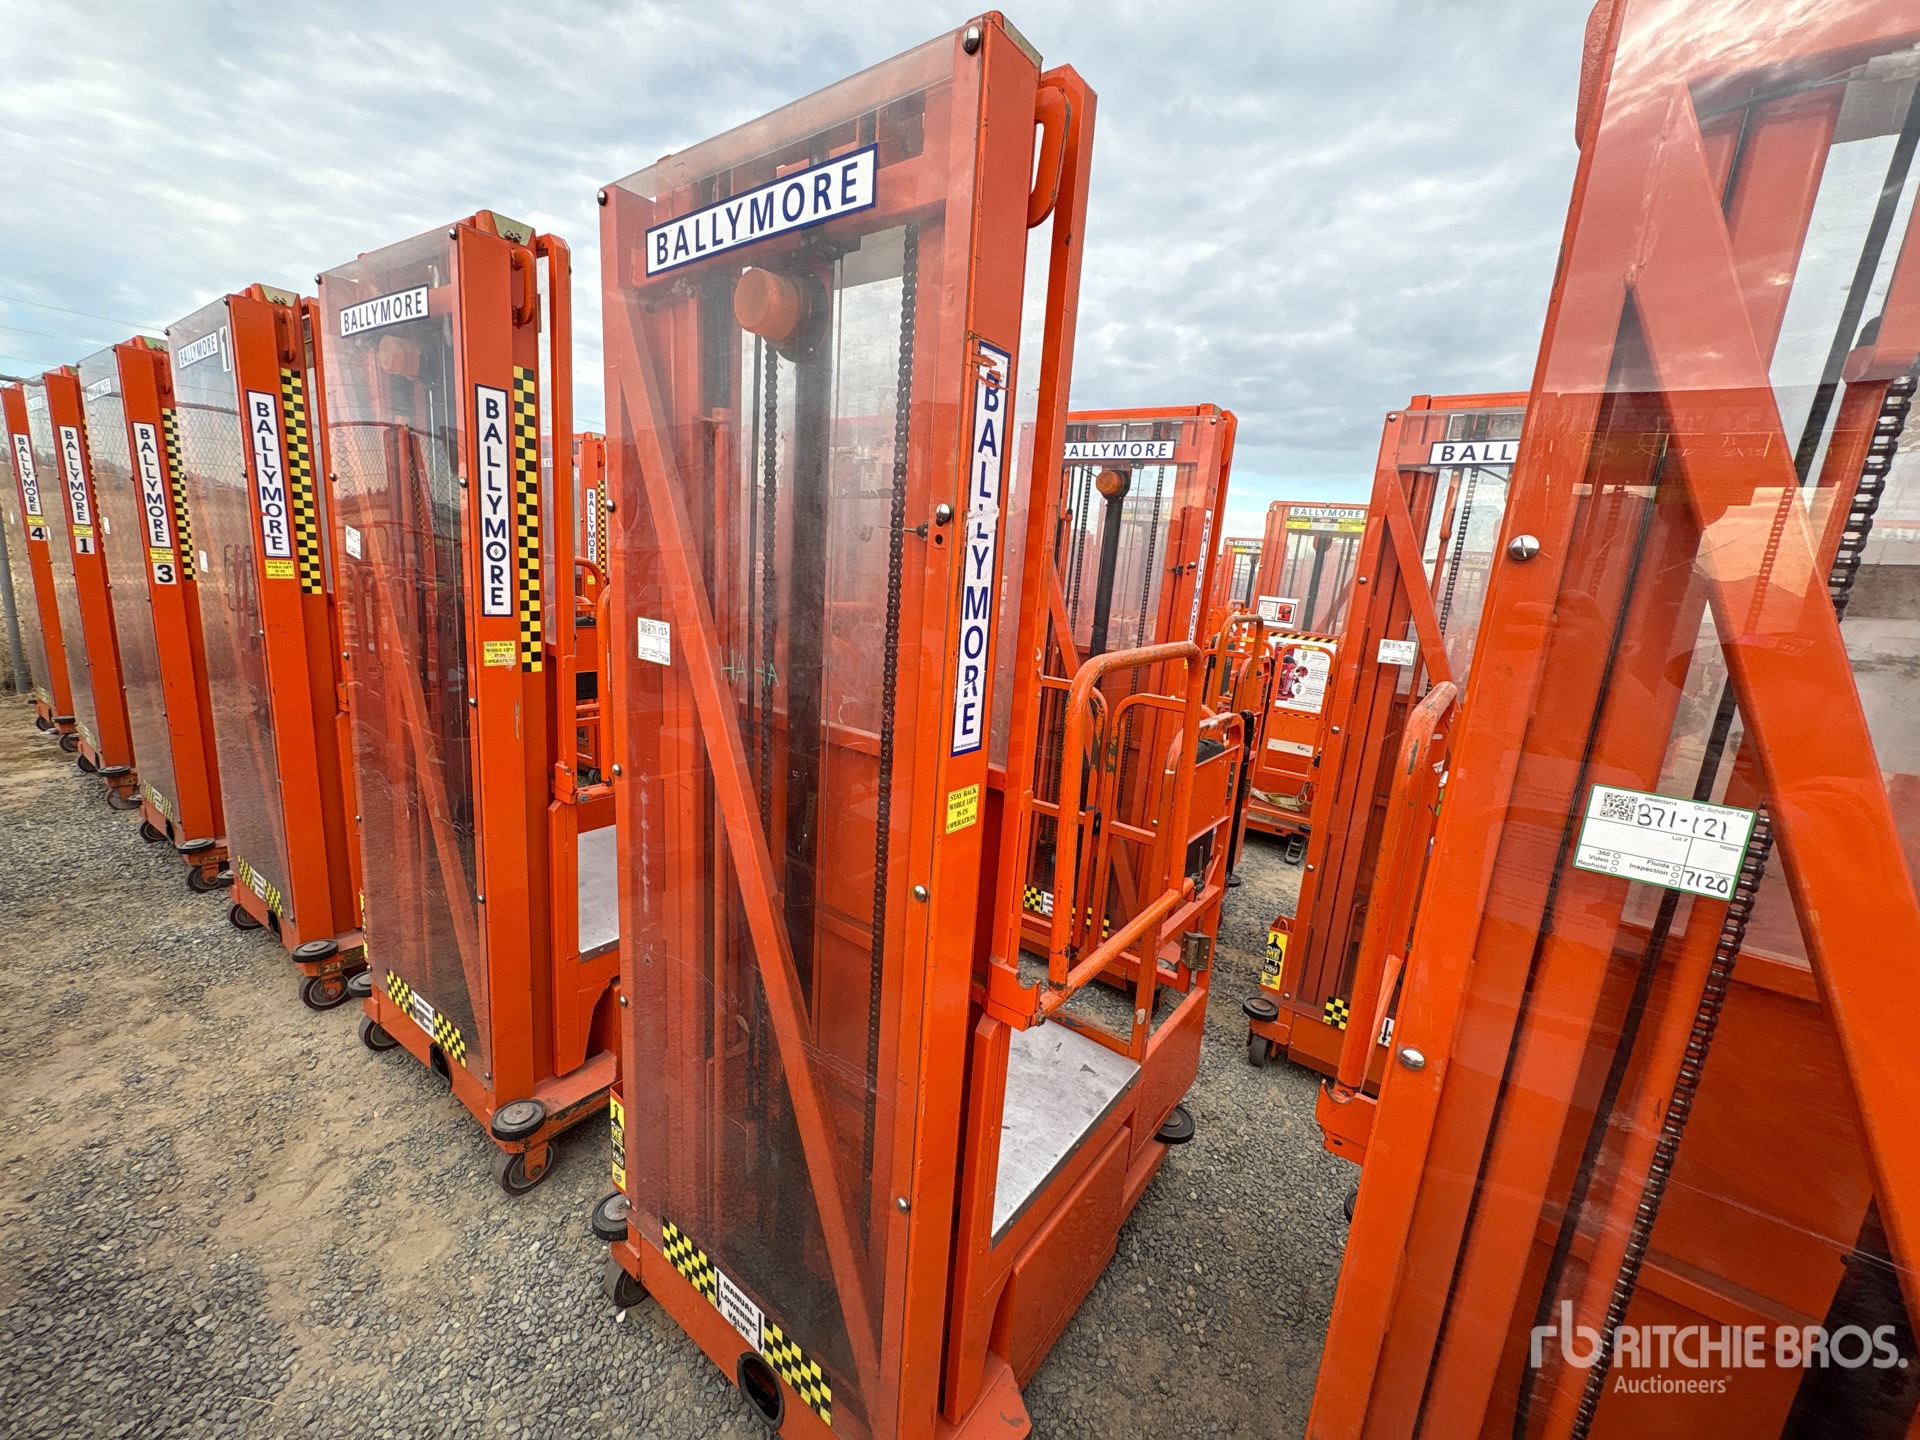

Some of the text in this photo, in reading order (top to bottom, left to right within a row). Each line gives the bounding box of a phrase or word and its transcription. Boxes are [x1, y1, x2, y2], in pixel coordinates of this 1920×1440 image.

[656, 161, 858, 266] BALLYMORE
[343, 288, 423, 333] BALLYMORE
[179, 335, 217, 367] BALLYMORE
[1441, 444, 1519, 462] BALL
[17, 437, 38, 513] BALLYMORE
[64, 430, 87, 521] BALLYMORE
[255, 401, 284, 551] BALLYMORE
[139, 428, 166, 543] BALLYMORE
[483, 397, 507, 607] BALLYMORE
[1293, 507, 1362, 518] BALLYMORE
[32, 527, 44, 540] 4
[79, 538, 90, 553] 1
[960, 373, 1000, 737] BALLYMORE
[157, 564, 173, 583] 3
[719, 645, 780, 688] HA HA
[950, 788, 977, 801] STAY BACK
[949, 796, 977, 810] WHILE LIFT
[956, 807, 969, 818] IS IN
[1736, 812, 1749, 820] Tag
[946, 814, 976, 830] OPERATION
[1672, 835, 1683, 843] Lot
[1597, 849, 1611, 857] 360
[1719, 844, 1739, 854] Notes
[1577, 859, 1608, 871] Rephoto
[1588, 854, 1609, 864] Video
[1646, 859, 1670, 870] Fluids
[1629, 863, 1669, 876] Inspection
[1266, 949, 1280, 958] ME
[1264, 964, 1278, 973] YOU
[723, 1281, 755, 1317] MANUAL
[720, 1290, 757, 1332] LOWERING
[728, 1309, 750, 1338] VALVE
